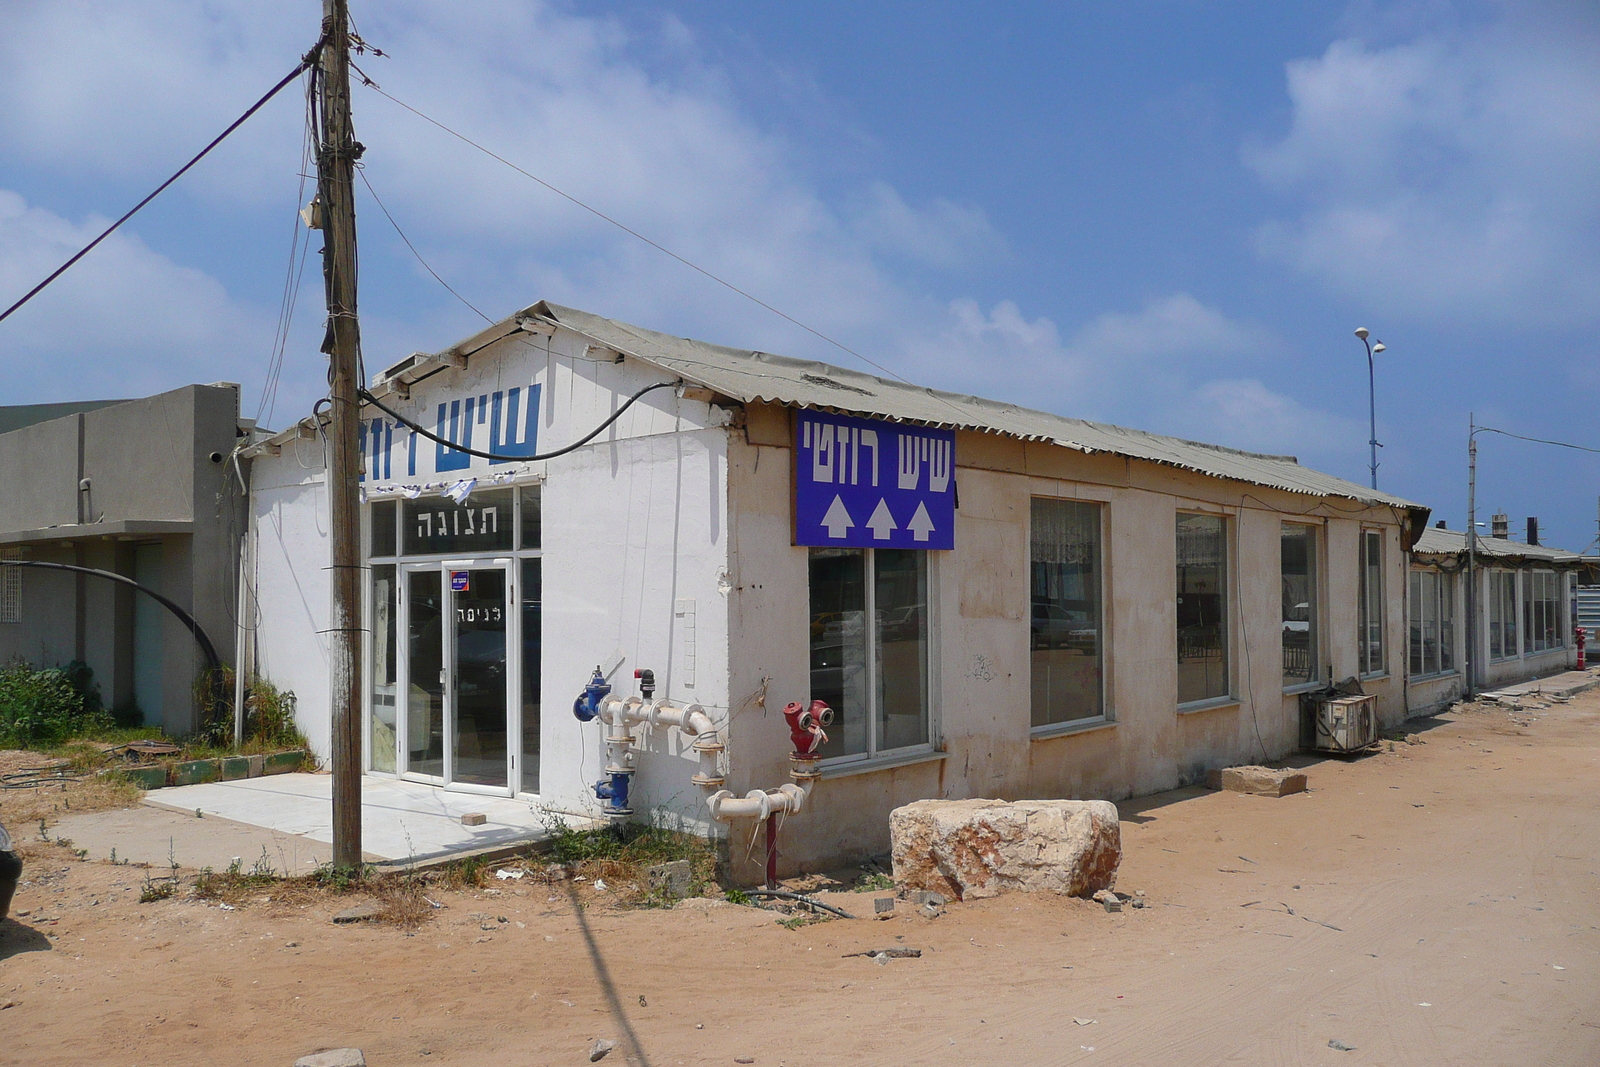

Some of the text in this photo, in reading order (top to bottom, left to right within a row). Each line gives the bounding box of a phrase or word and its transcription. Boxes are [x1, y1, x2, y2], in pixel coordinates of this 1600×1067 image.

[434, 383, 542, 473] שיש
[803, 421, 950, 493] שיש רוזטי
[418, 500, 498, 538] תצוגה
[456, 607, 501, 623] כניסה
